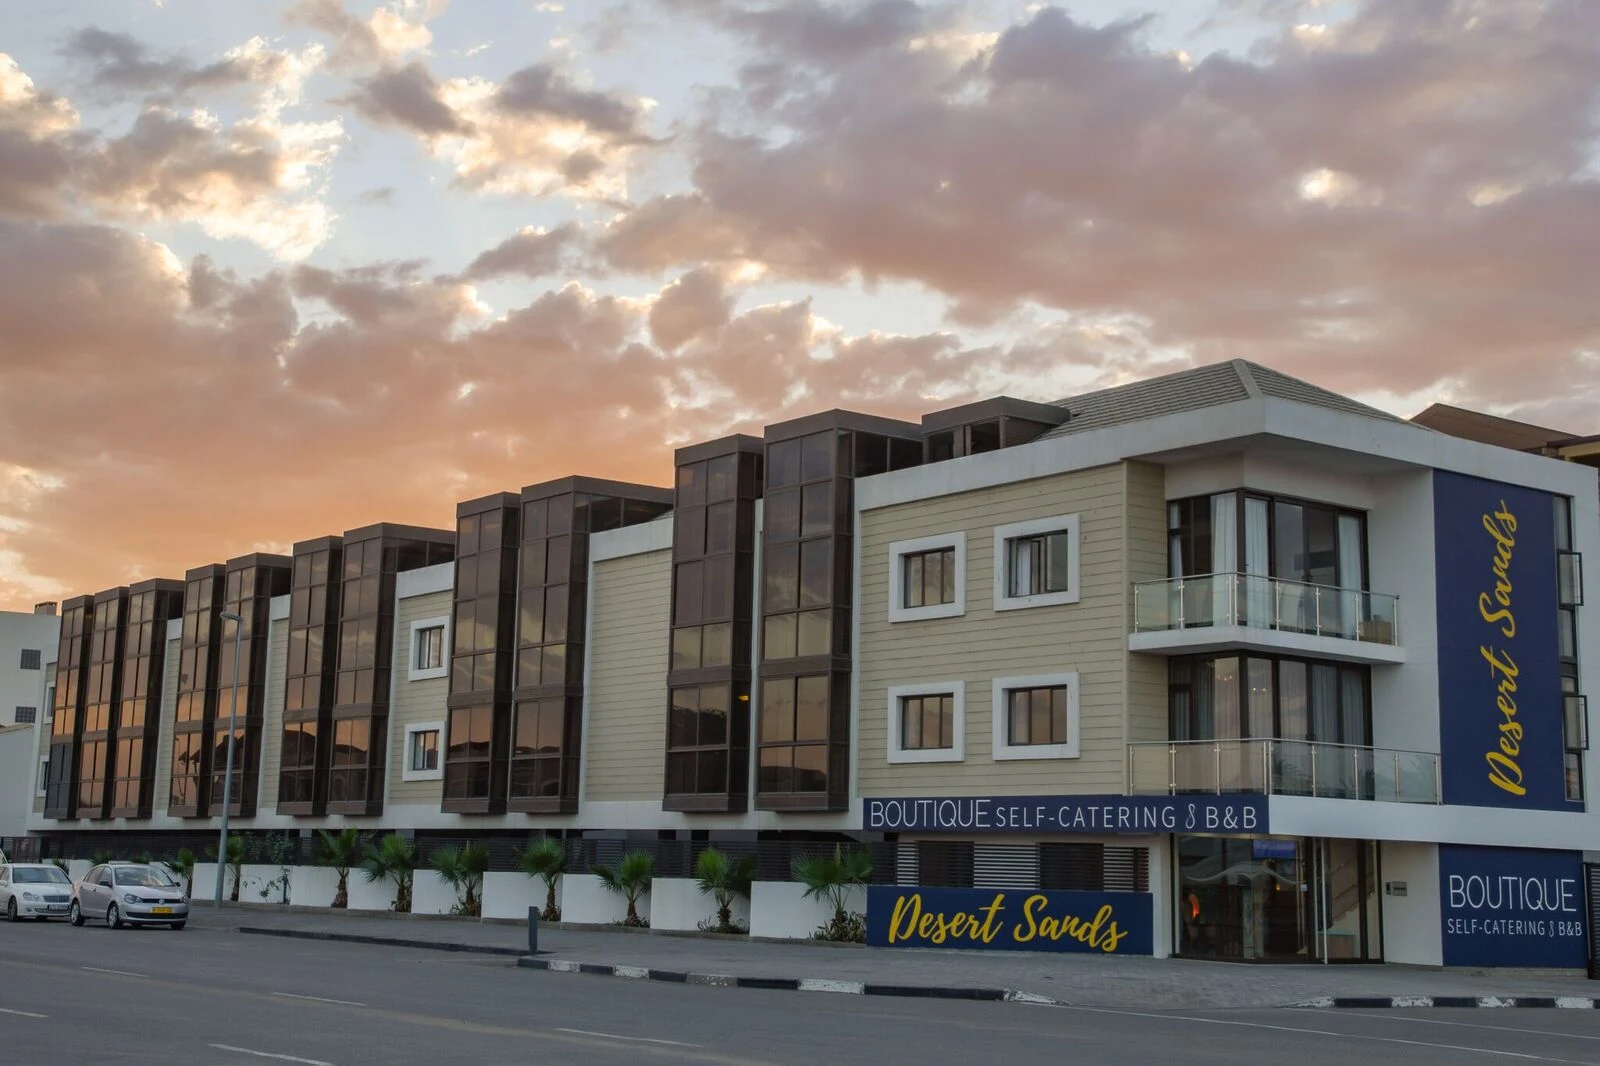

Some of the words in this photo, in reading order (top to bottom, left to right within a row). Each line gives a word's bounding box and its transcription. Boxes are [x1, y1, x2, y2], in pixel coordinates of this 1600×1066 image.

[1479, 499, 1518, 639] Sands
[1480, 645, 1526, 796] Desert
[870, 799, 991, 828] BOUTIQUE
[996, 805, 1176, 829] SELF-CATERING
[1205, 805, 1258, 829] B&B
[1449, 874, 1577, 912] BOUTIQUE
[888, 893, 1005, 944] Desert
[1013, 894, 1128, 953] Sands
[1447, 918, 1546, 936] SELF-CATERING
[1558, 921, 1583, 937] B&B
